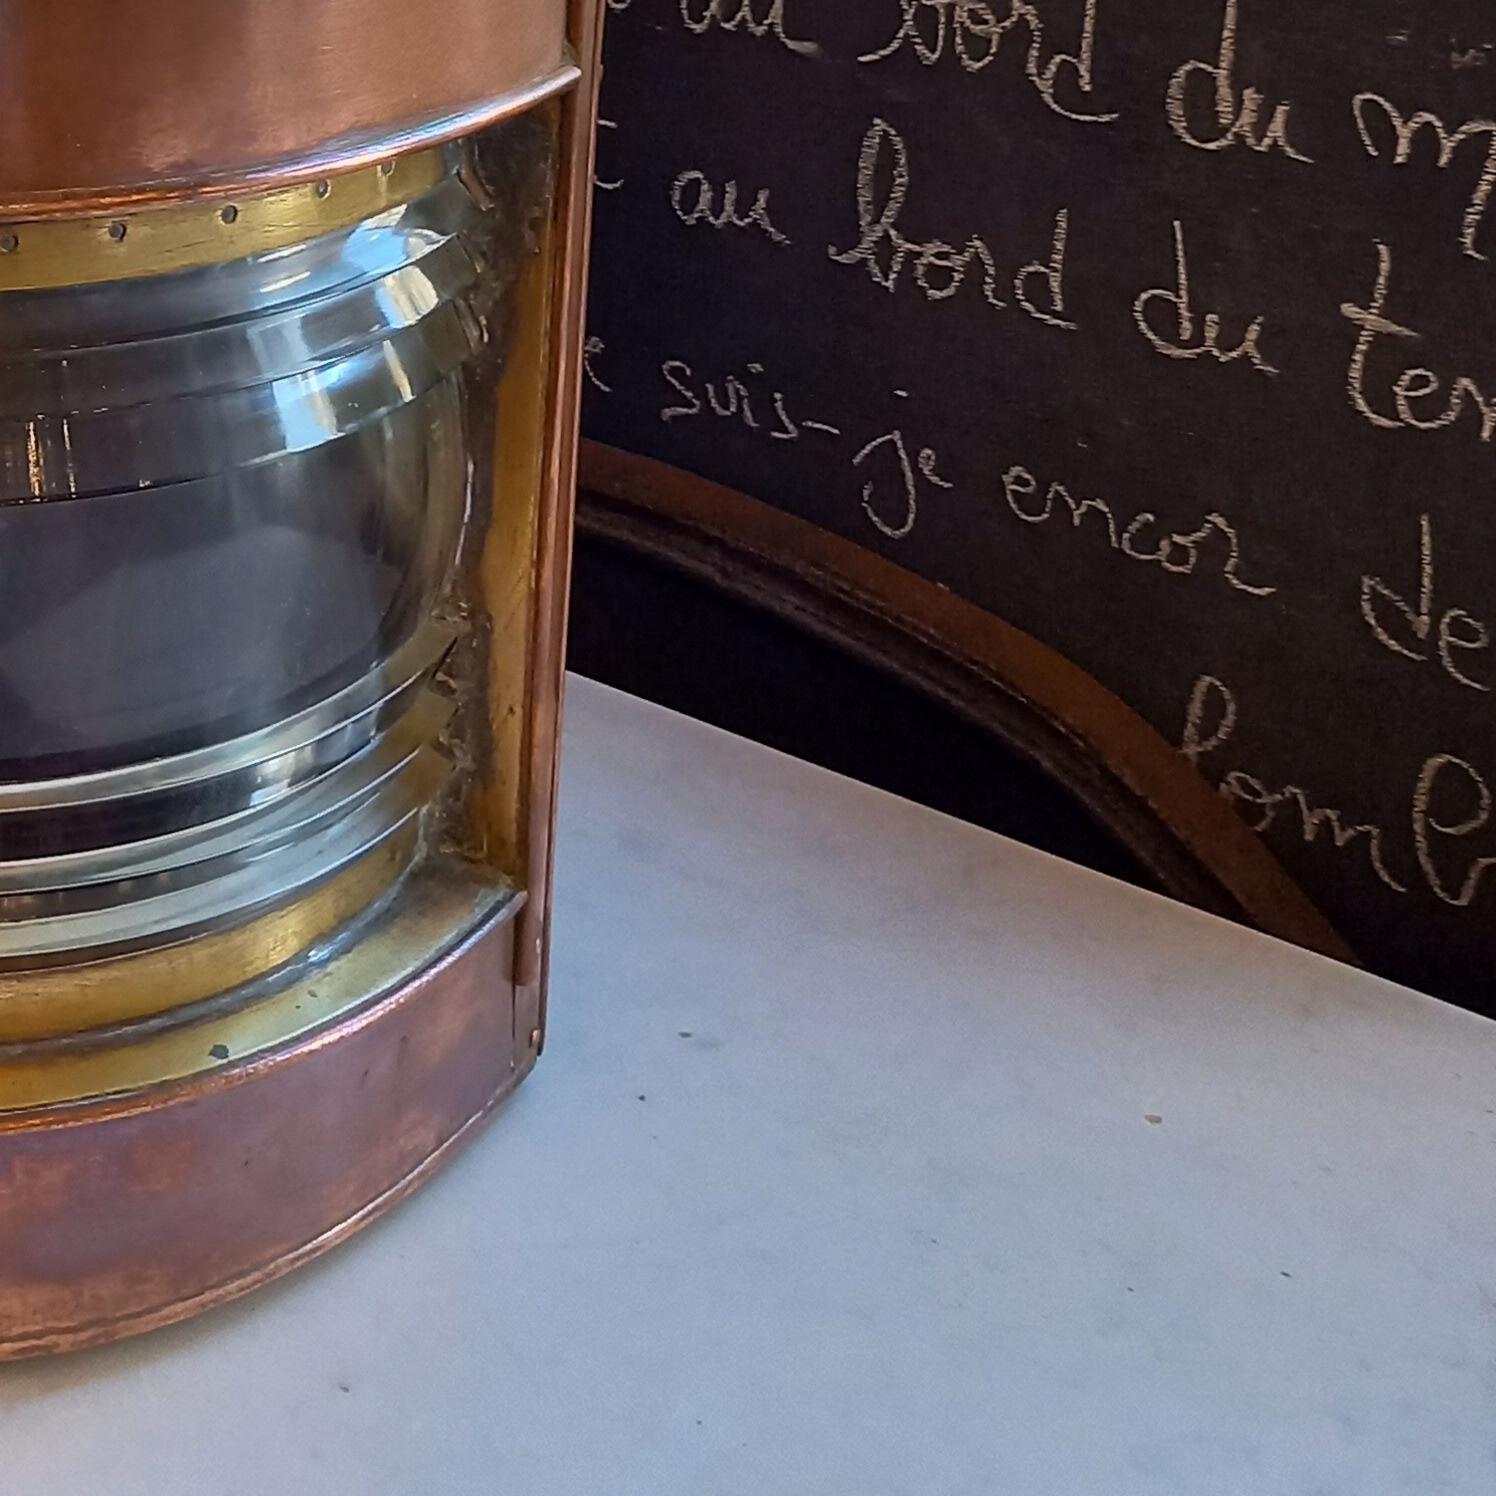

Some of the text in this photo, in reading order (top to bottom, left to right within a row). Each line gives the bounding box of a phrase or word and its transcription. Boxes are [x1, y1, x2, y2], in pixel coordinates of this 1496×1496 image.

[670, 168, 792, 246] au
[826, 116, 1078, 329] bord
[1132, 219, 1280, 377] du
